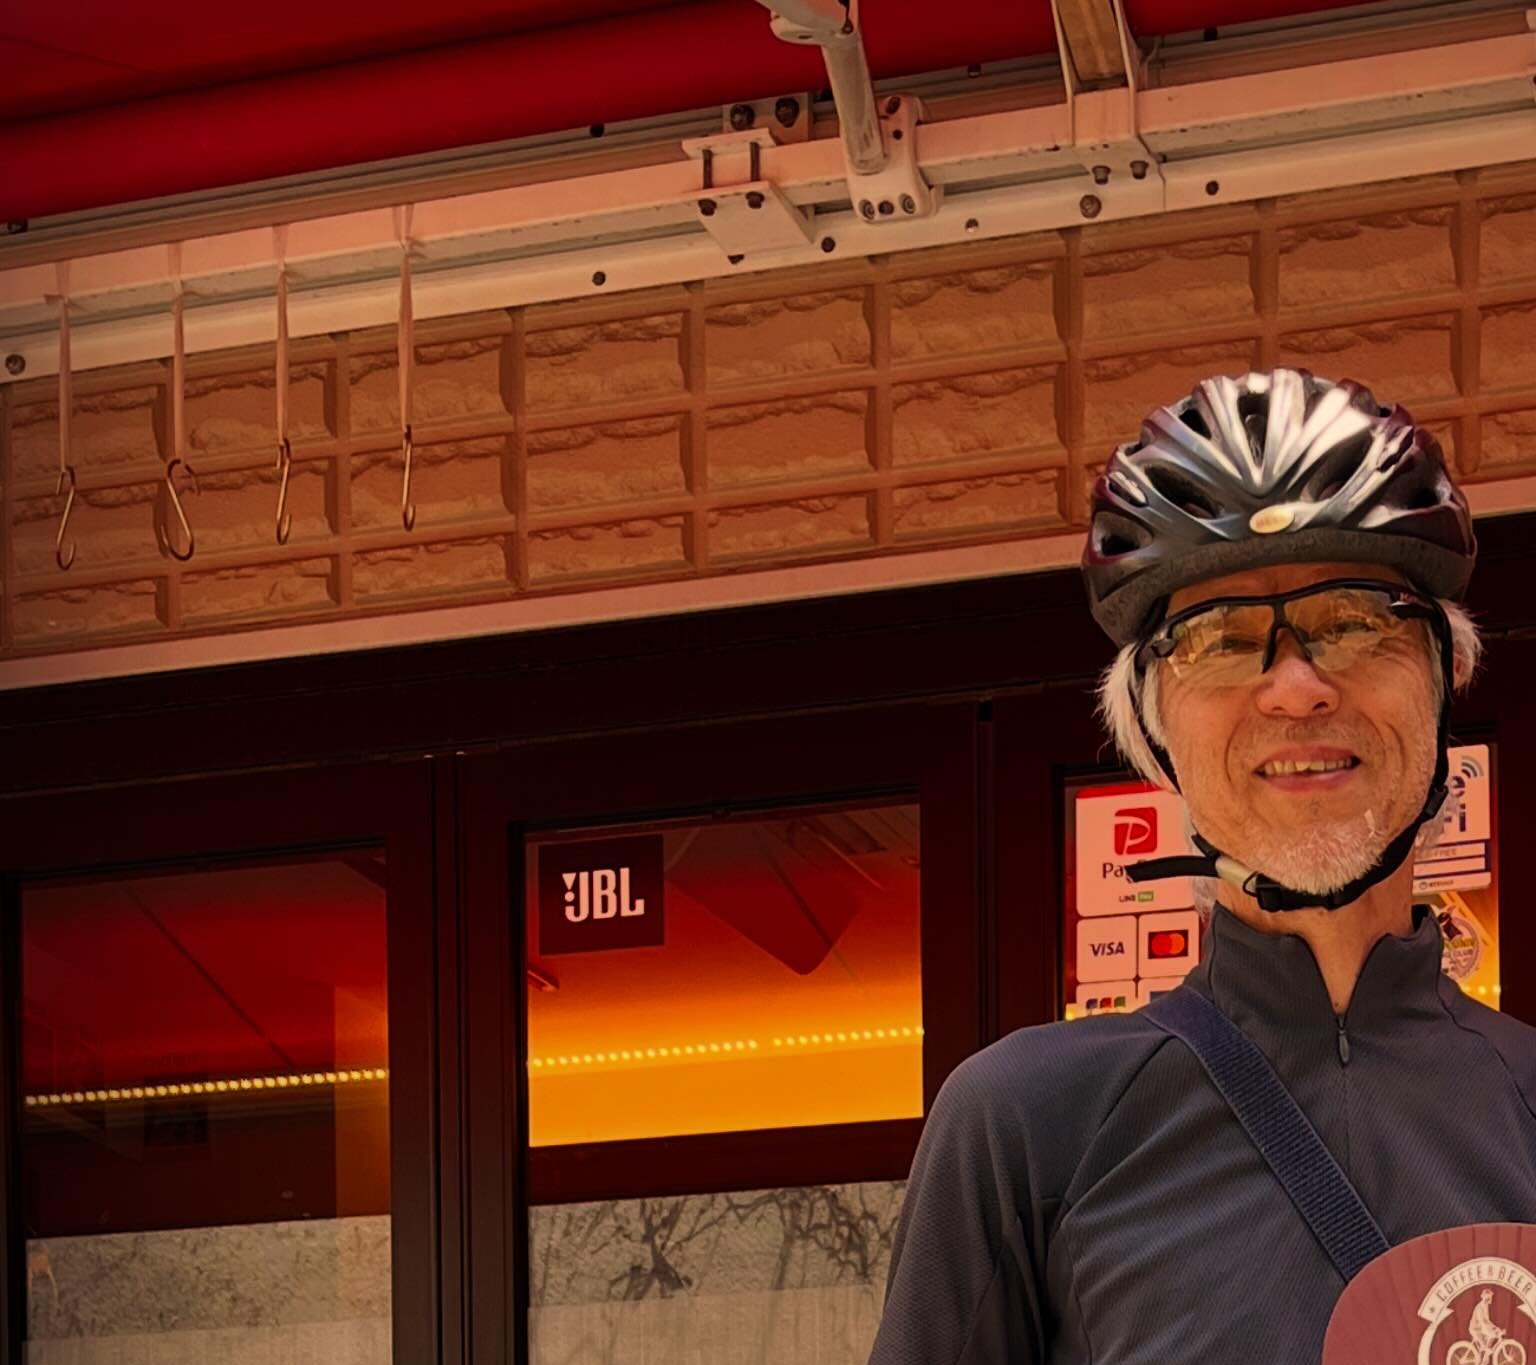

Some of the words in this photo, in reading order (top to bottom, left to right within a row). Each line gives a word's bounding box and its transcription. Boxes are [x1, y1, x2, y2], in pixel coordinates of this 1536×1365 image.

[563, 867, 645, 922] JBL
[1090, 941, 1125, 956] VISA
[1436, 1264, 1482, 1302] COFFEE
[1498, 1265, 1534, 1294] BEER
